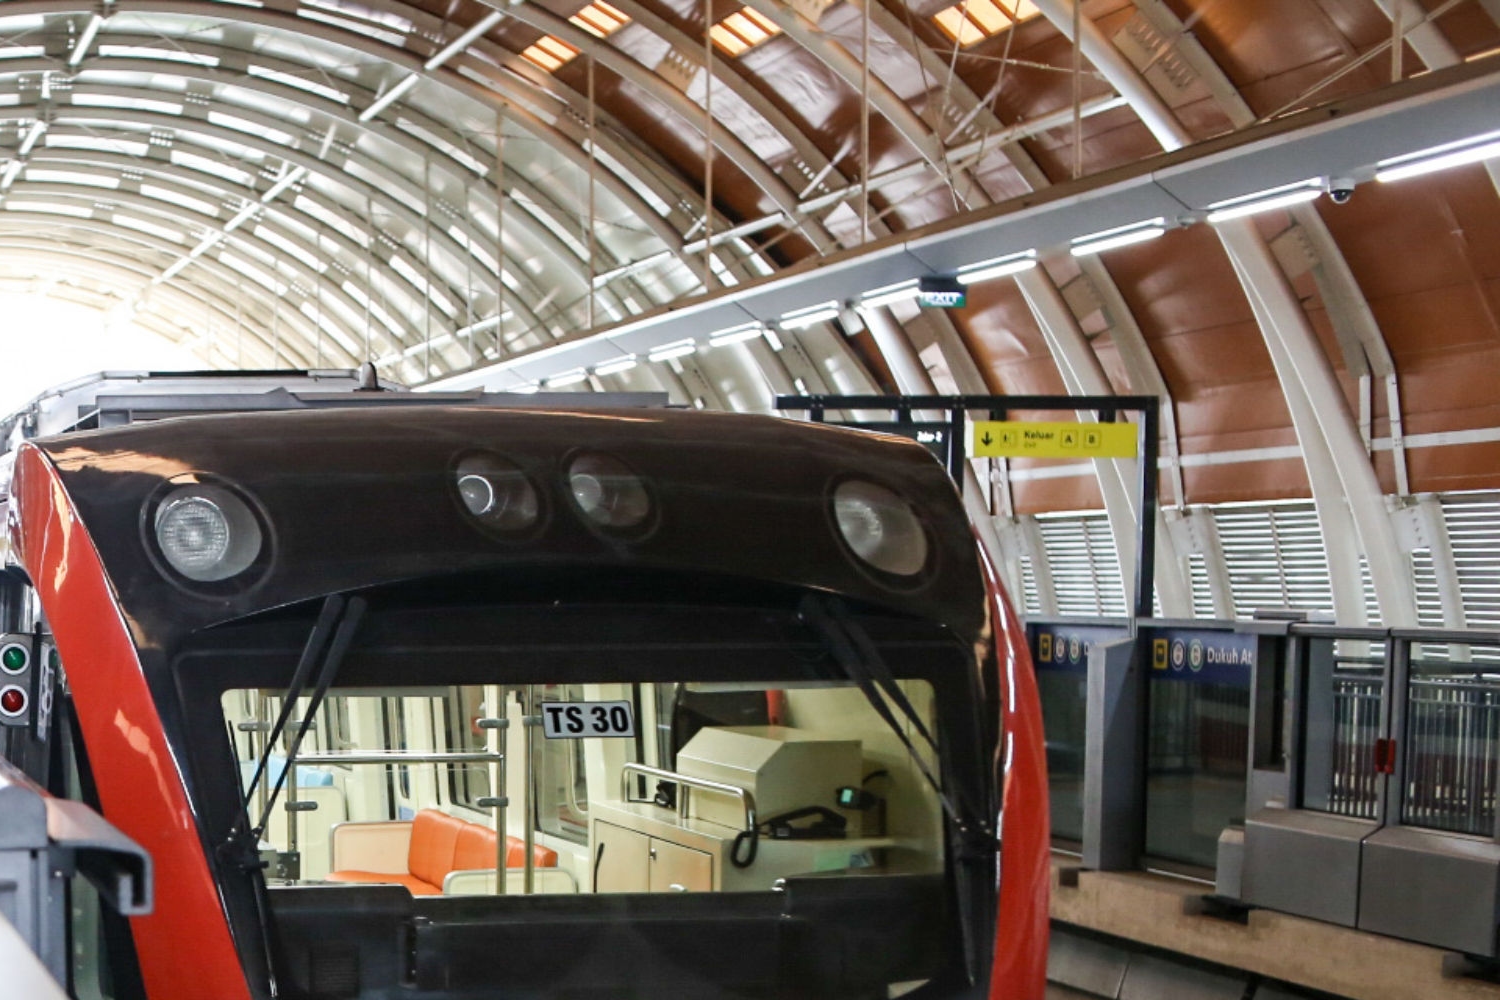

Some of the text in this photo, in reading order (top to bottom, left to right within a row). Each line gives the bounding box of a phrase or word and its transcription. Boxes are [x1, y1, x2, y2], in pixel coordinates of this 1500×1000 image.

[1064, 434, 1073, 444] A
[1207, 646, 1239, 664] Dukuh
[546, 706, 629, 733] TS 30
